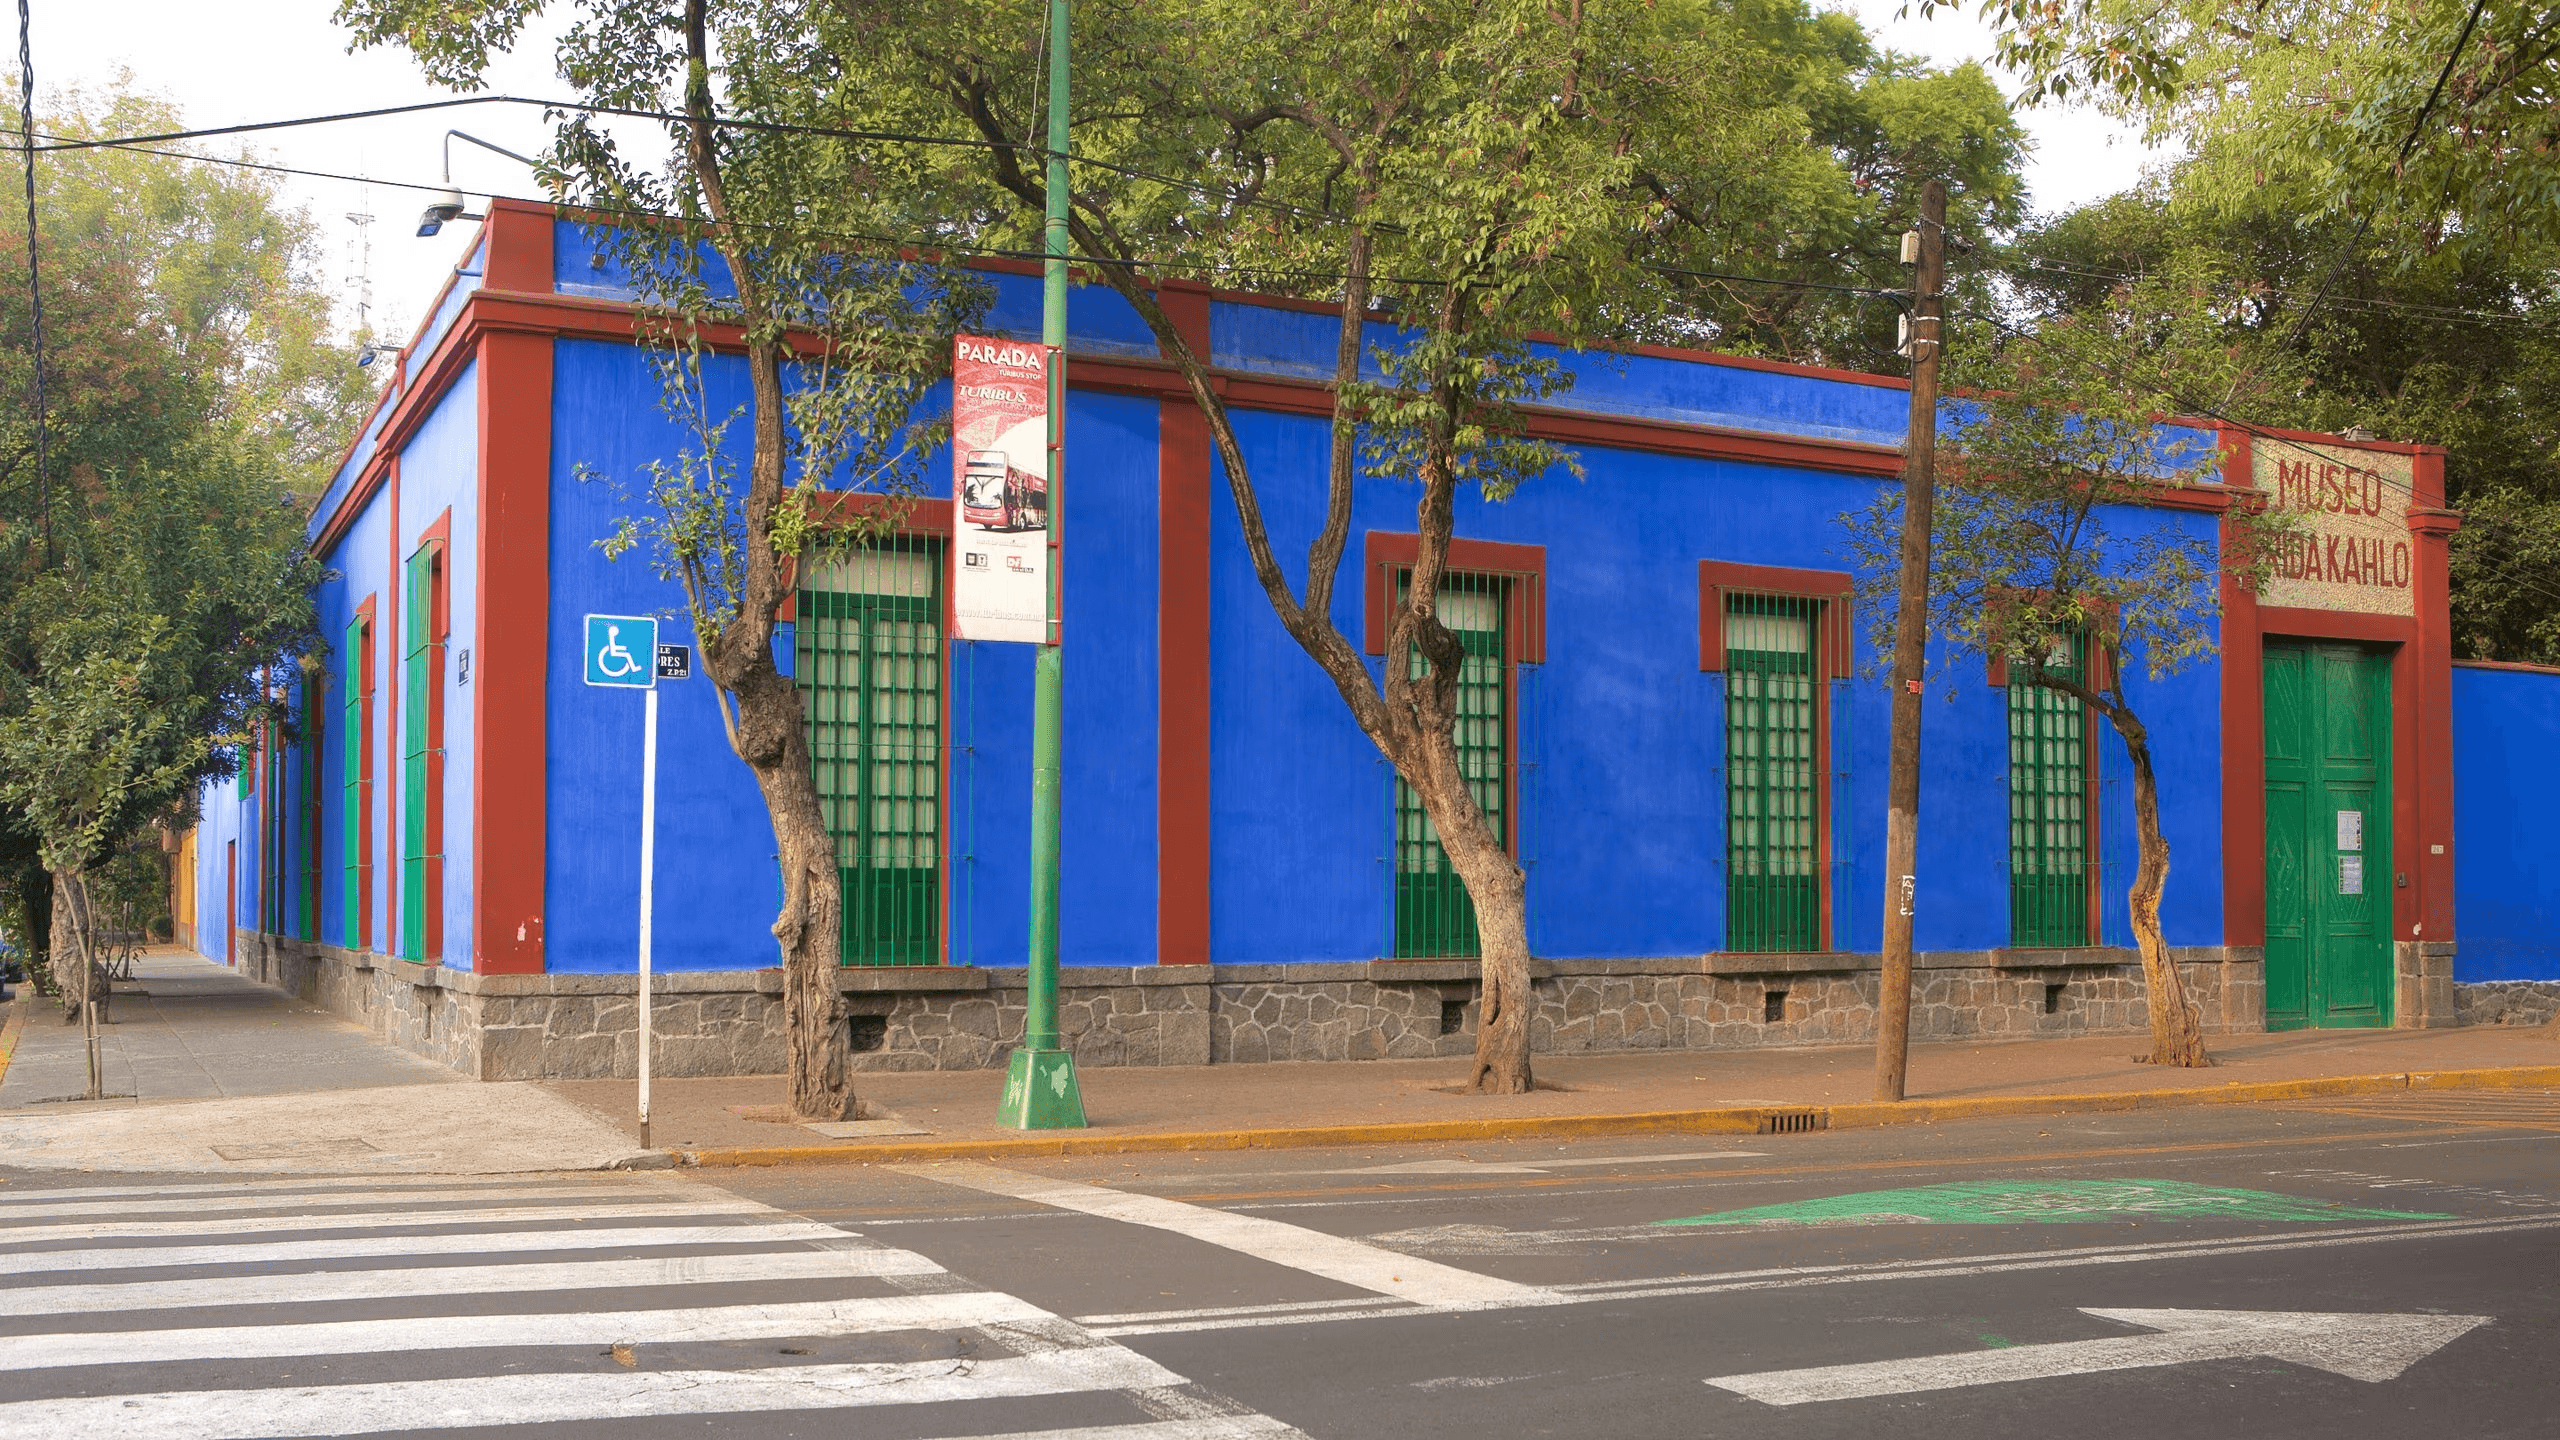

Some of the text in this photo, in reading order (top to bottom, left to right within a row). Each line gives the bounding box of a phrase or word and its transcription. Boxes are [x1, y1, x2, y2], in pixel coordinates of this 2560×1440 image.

[958, 342, 1041, 371] PARADA
[959, 385, 1027, 403] TURIBUS
[2279, 459, 2381, 517] MUSEO
[2326, 533, 2409, 588] KAHLO
